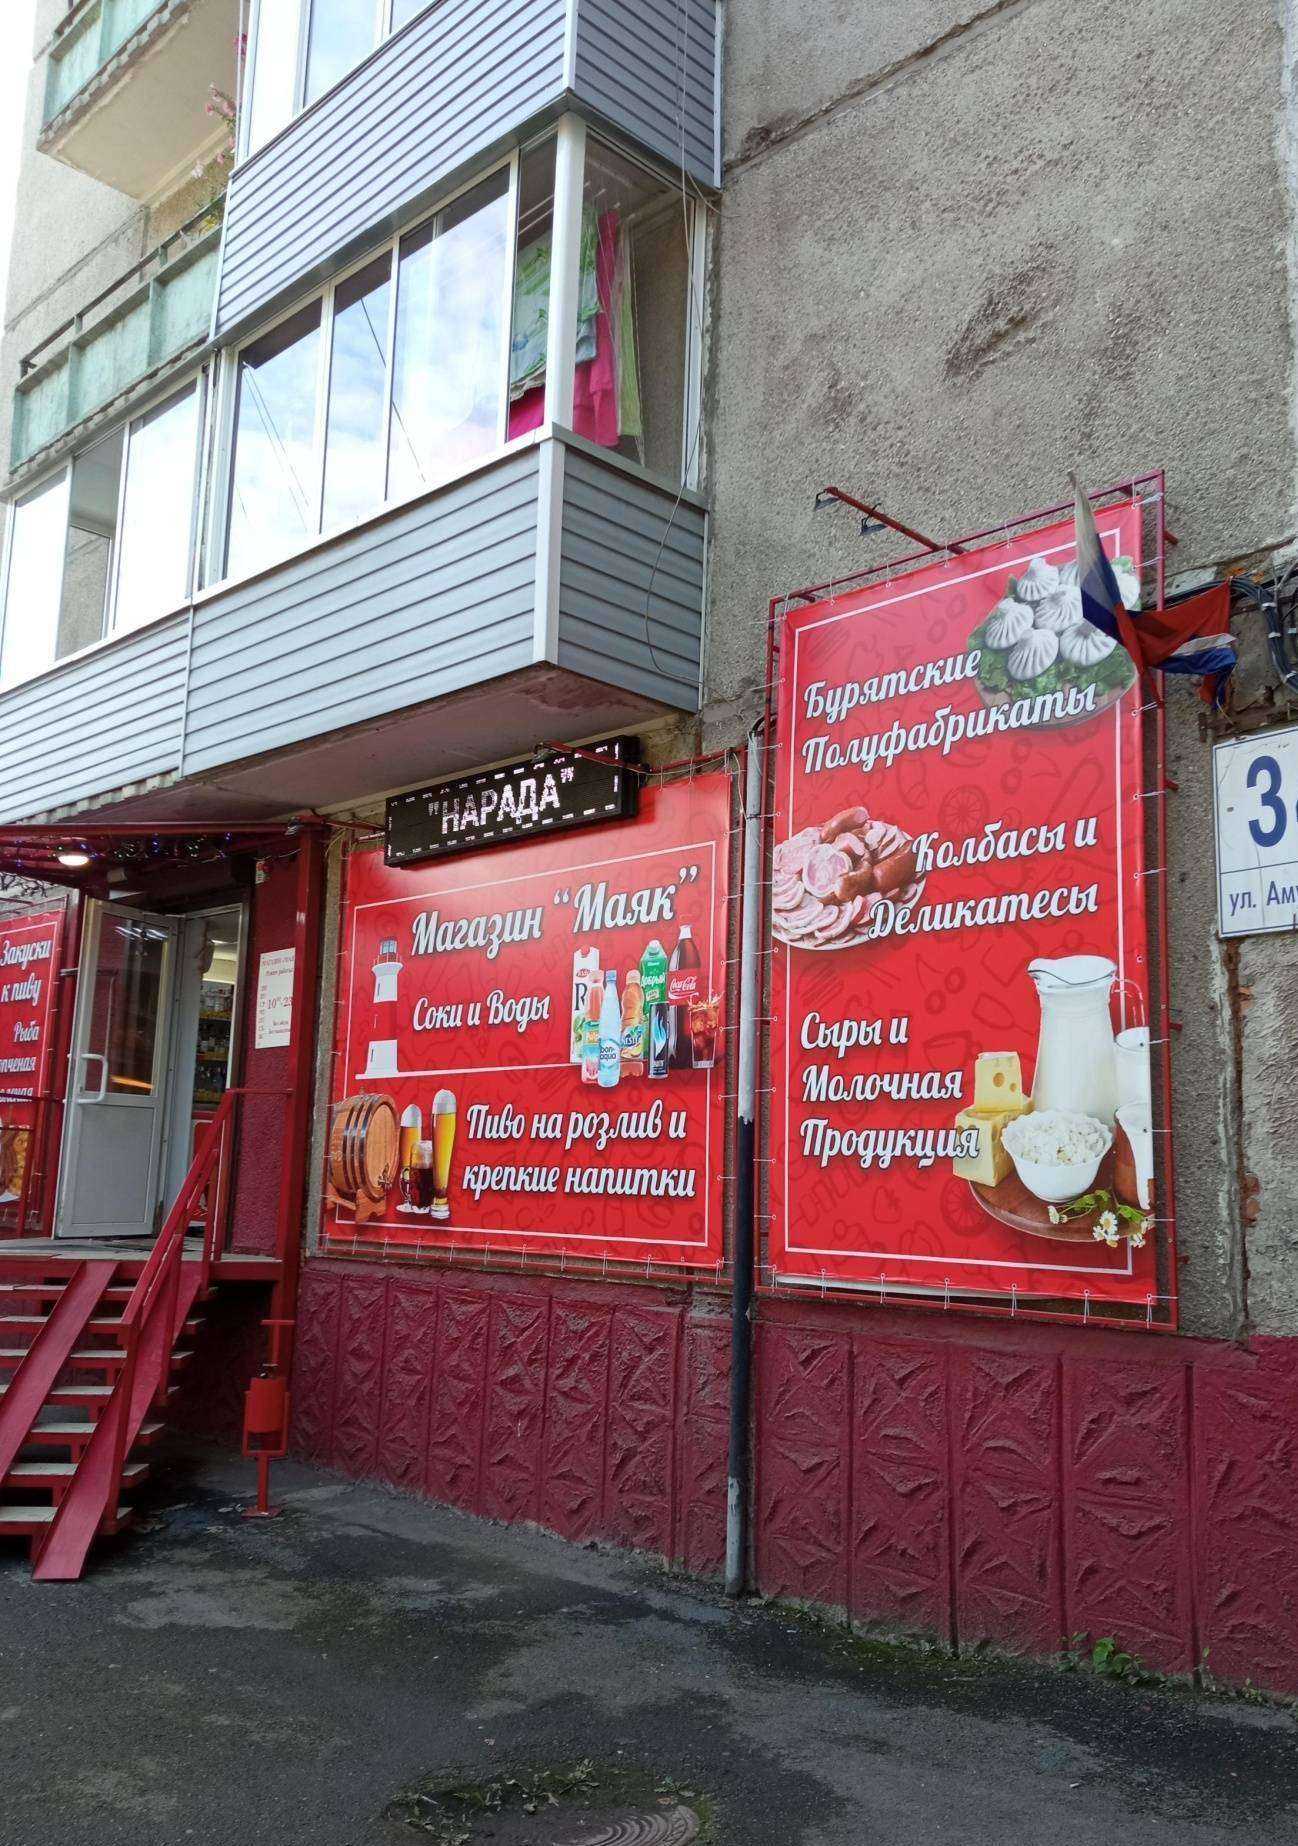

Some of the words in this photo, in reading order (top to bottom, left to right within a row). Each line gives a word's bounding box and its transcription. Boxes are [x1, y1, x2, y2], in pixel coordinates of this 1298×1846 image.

[803, 648, 982, 721] Бурятские
[801, 682, 1097, 775] Полуфабрикаты
[1246, 755, 1298, 848] 3
[911, 819, 1066, 874] Колбасы
[1074, 815, 1099, 847] и
[867, 883, 1099, 940] Деликатесы
[1229, 891, 1257, 917] ул.
[1266, 880, 1298, 906] Ам
[0, 940, 51, 970] Закуски
[411, 907, 544, 959] Магазин
[1, 984, 11, 1003] к
[11, 972, 42, 1007] пиву
[413, 997, 463, 1031] Соки
[467, 1002, 482, 1026] и
[486, 989, 551, 1033] Воды
[13, 1021, 40, 1043] Рыба
[800, 1012, 882, 1058] Сыры
[888, 1013, 909, 1044] и
[801, 1065, 963, 1103] Молочная
[466, 1104, 526, 1140] Пиво
[531, 1111, 564, 1139] на
[565, 1099, 663, 1151] розлив
[669, 1110, 687, 1139] и
[800, 1117, 980, 1169] Продукция
[462, 1164, 561, 1201] крепкие
[564, 1166, 696, 1198] напитки
